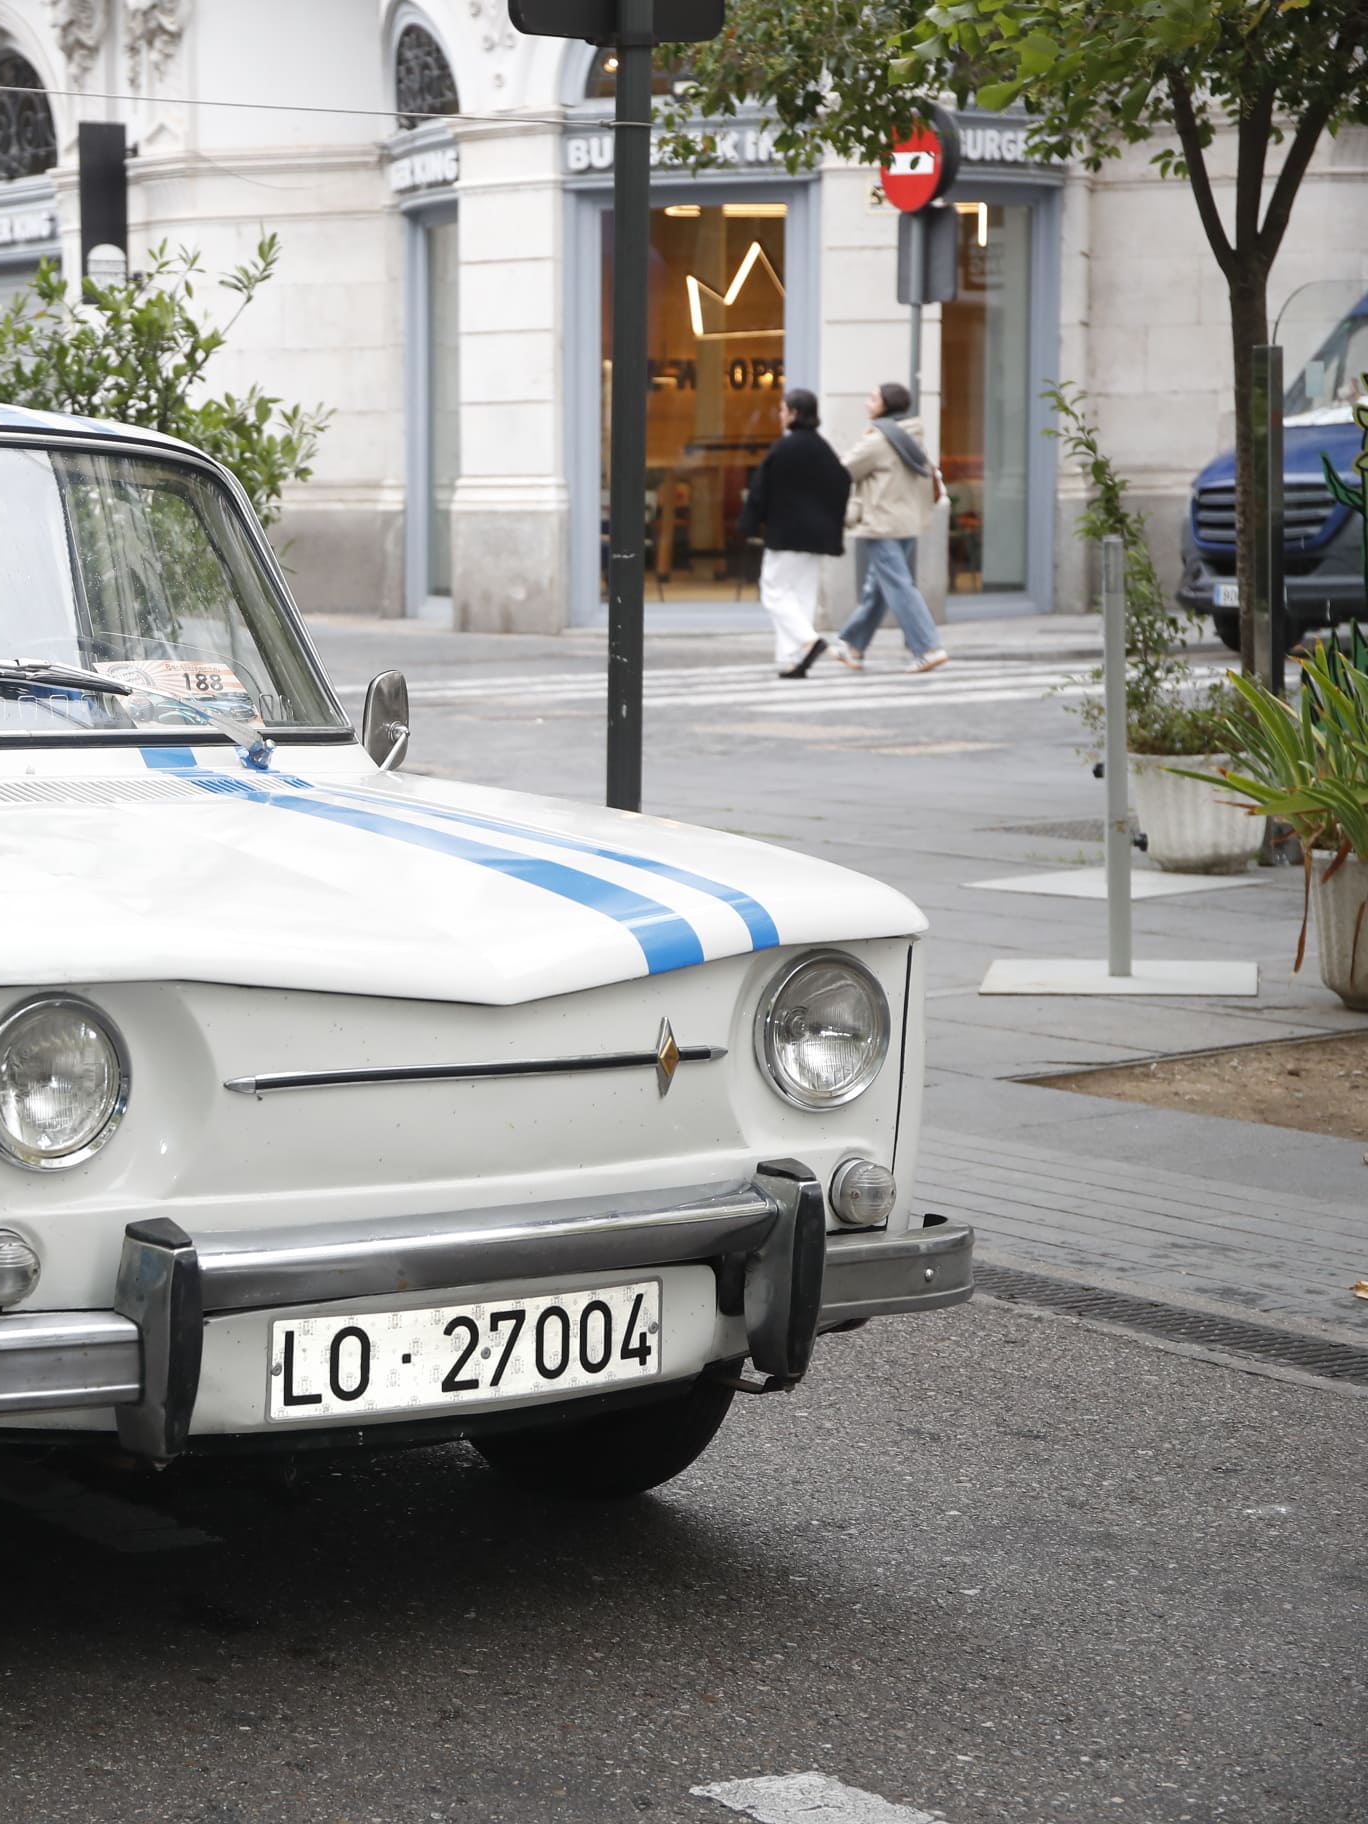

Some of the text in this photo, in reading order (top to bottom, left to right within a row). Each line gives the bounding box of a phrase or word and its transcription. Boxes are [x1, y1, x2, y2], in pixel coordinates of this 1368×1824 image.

[714, 130, 790, 163] KIN
[959, 128, 1048, 164] URGE
[183, 673, 223, 691] 188
[283, 1325, 371, 1406] LO
[441, 1293, 651, 1392] 27004
